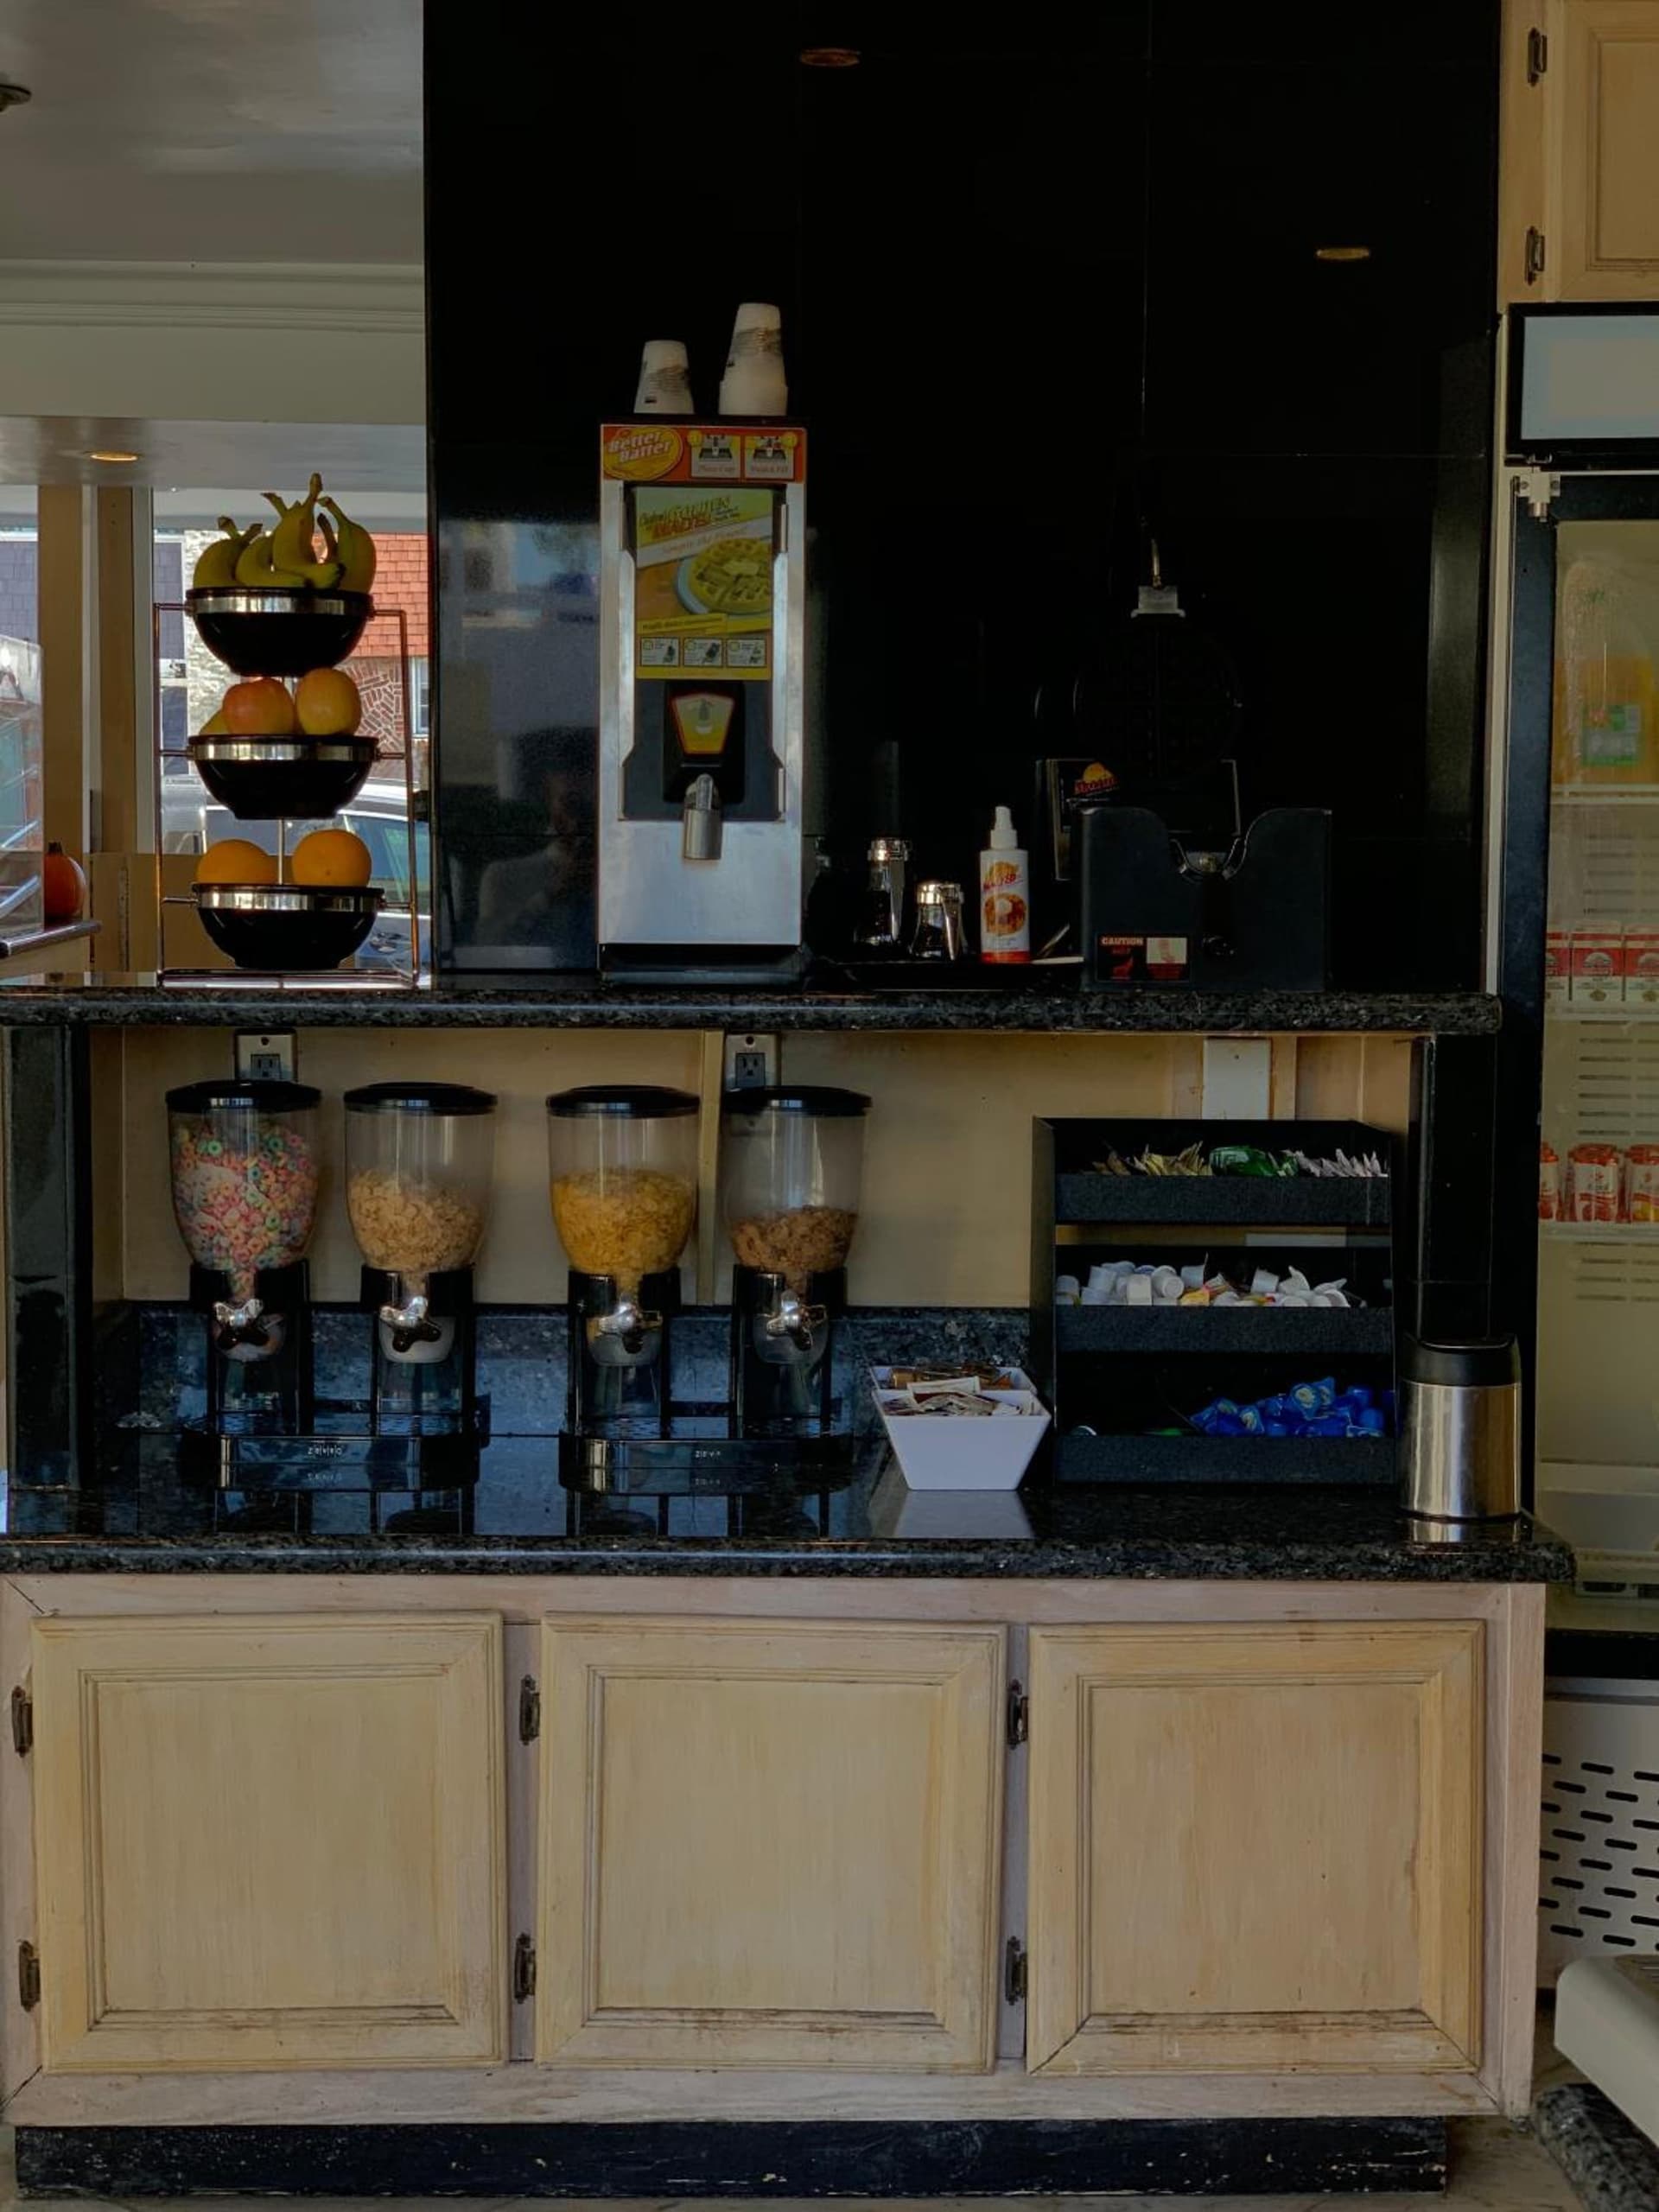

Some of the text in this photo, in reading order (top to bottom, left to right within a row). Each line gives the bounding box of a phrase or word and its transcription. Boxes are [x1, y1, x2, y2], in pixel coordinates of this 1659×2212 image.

[607, 431, 661, 453] Better
[619, 442, 671, 462] Batter
[1101, 937, 1144, 946] CAUTION
